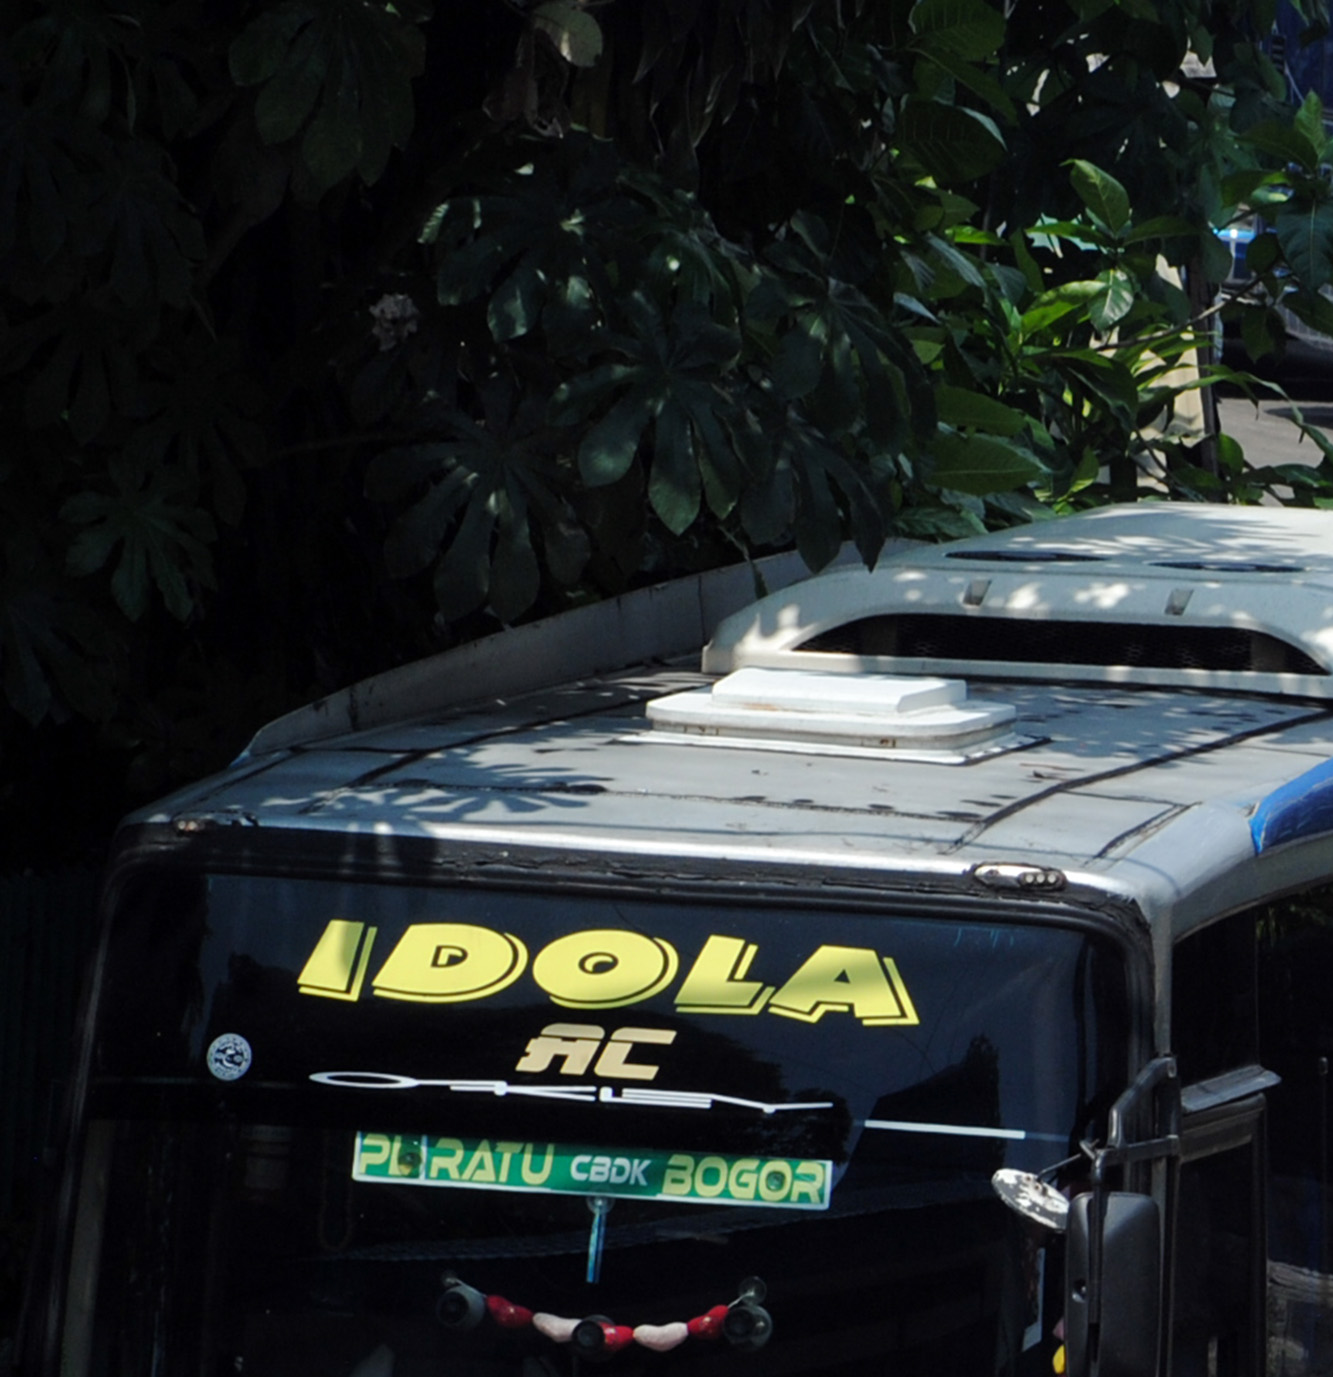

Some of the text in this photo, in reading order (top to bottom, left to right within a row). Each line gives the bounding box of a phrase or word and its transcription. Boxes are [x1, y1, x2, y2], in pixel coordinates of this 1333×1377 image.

[296, 918, 921, 1026] IDOLA
[515, 1021, 678, 1080] AC
[429, 1137, 556, 1186] RATU
[569, 1154, 653, 1187] CBDK
[661, 1153, 827, 1205] BOGOR
